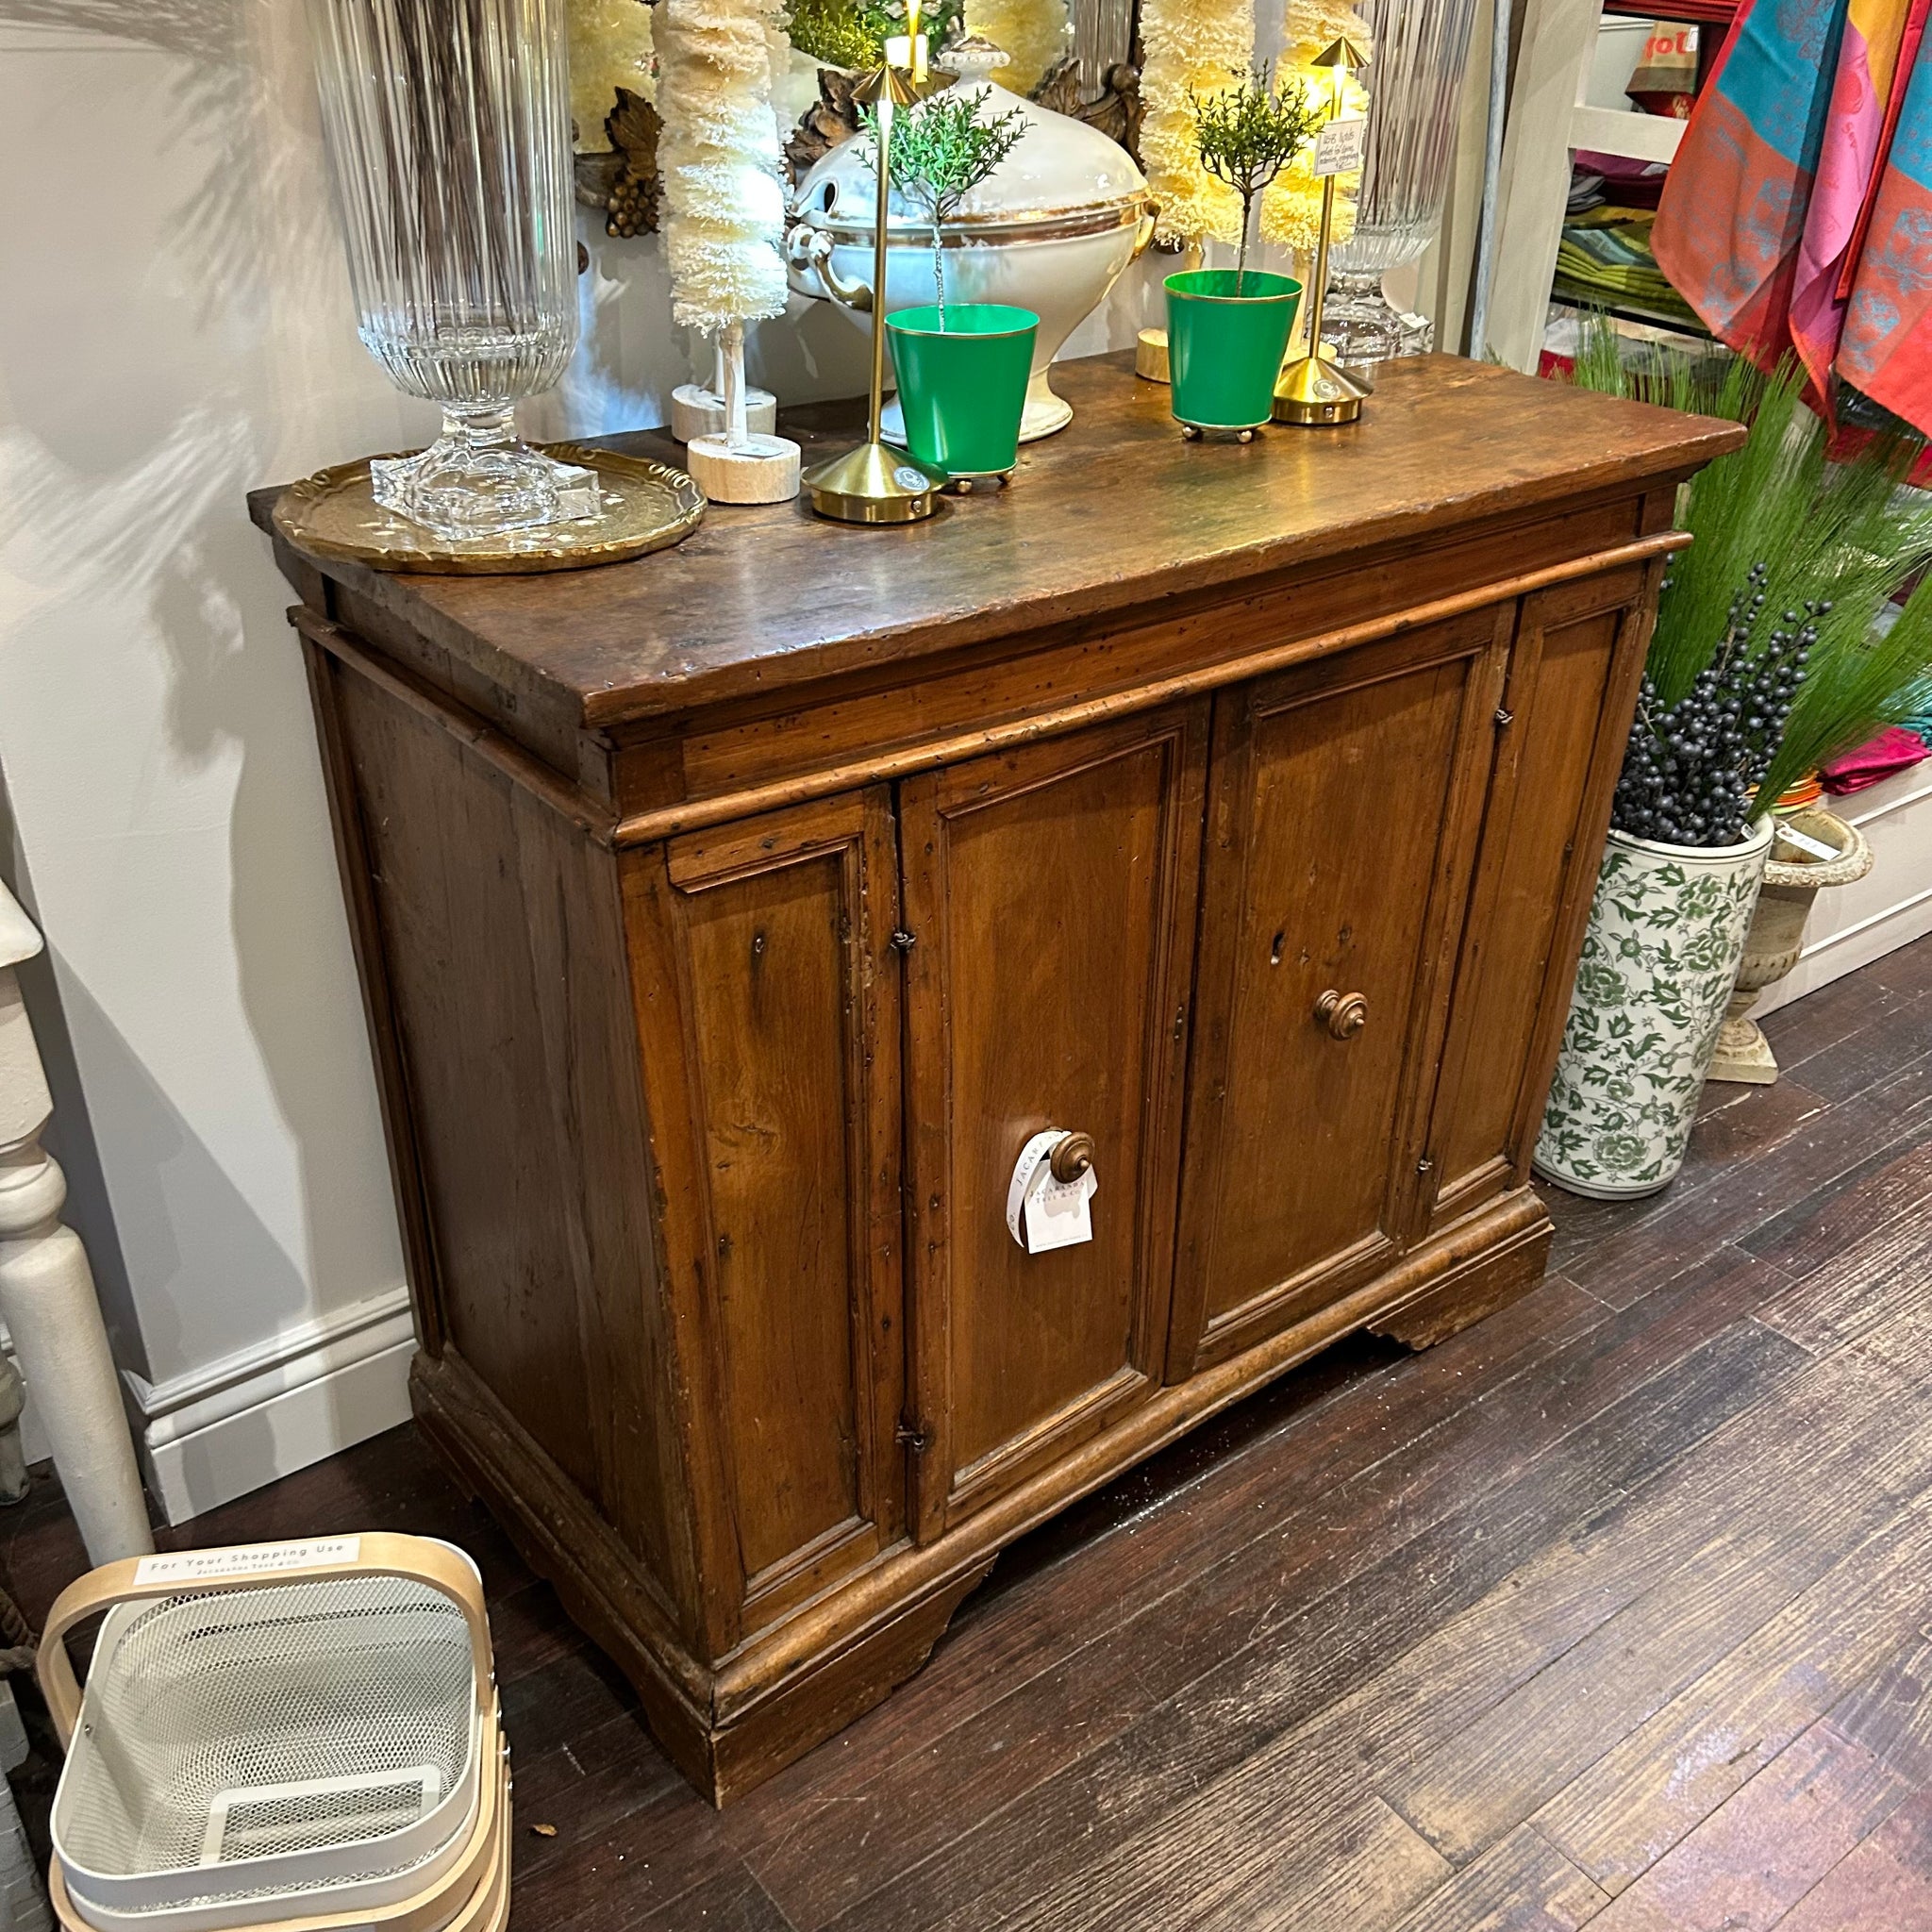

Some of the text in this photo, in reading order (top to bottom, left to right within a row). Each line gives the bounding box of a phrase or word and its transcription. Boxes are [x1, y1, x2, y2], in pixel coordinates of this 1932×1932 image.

[150, 1544, 343, 1571] For Your Shopping Use
